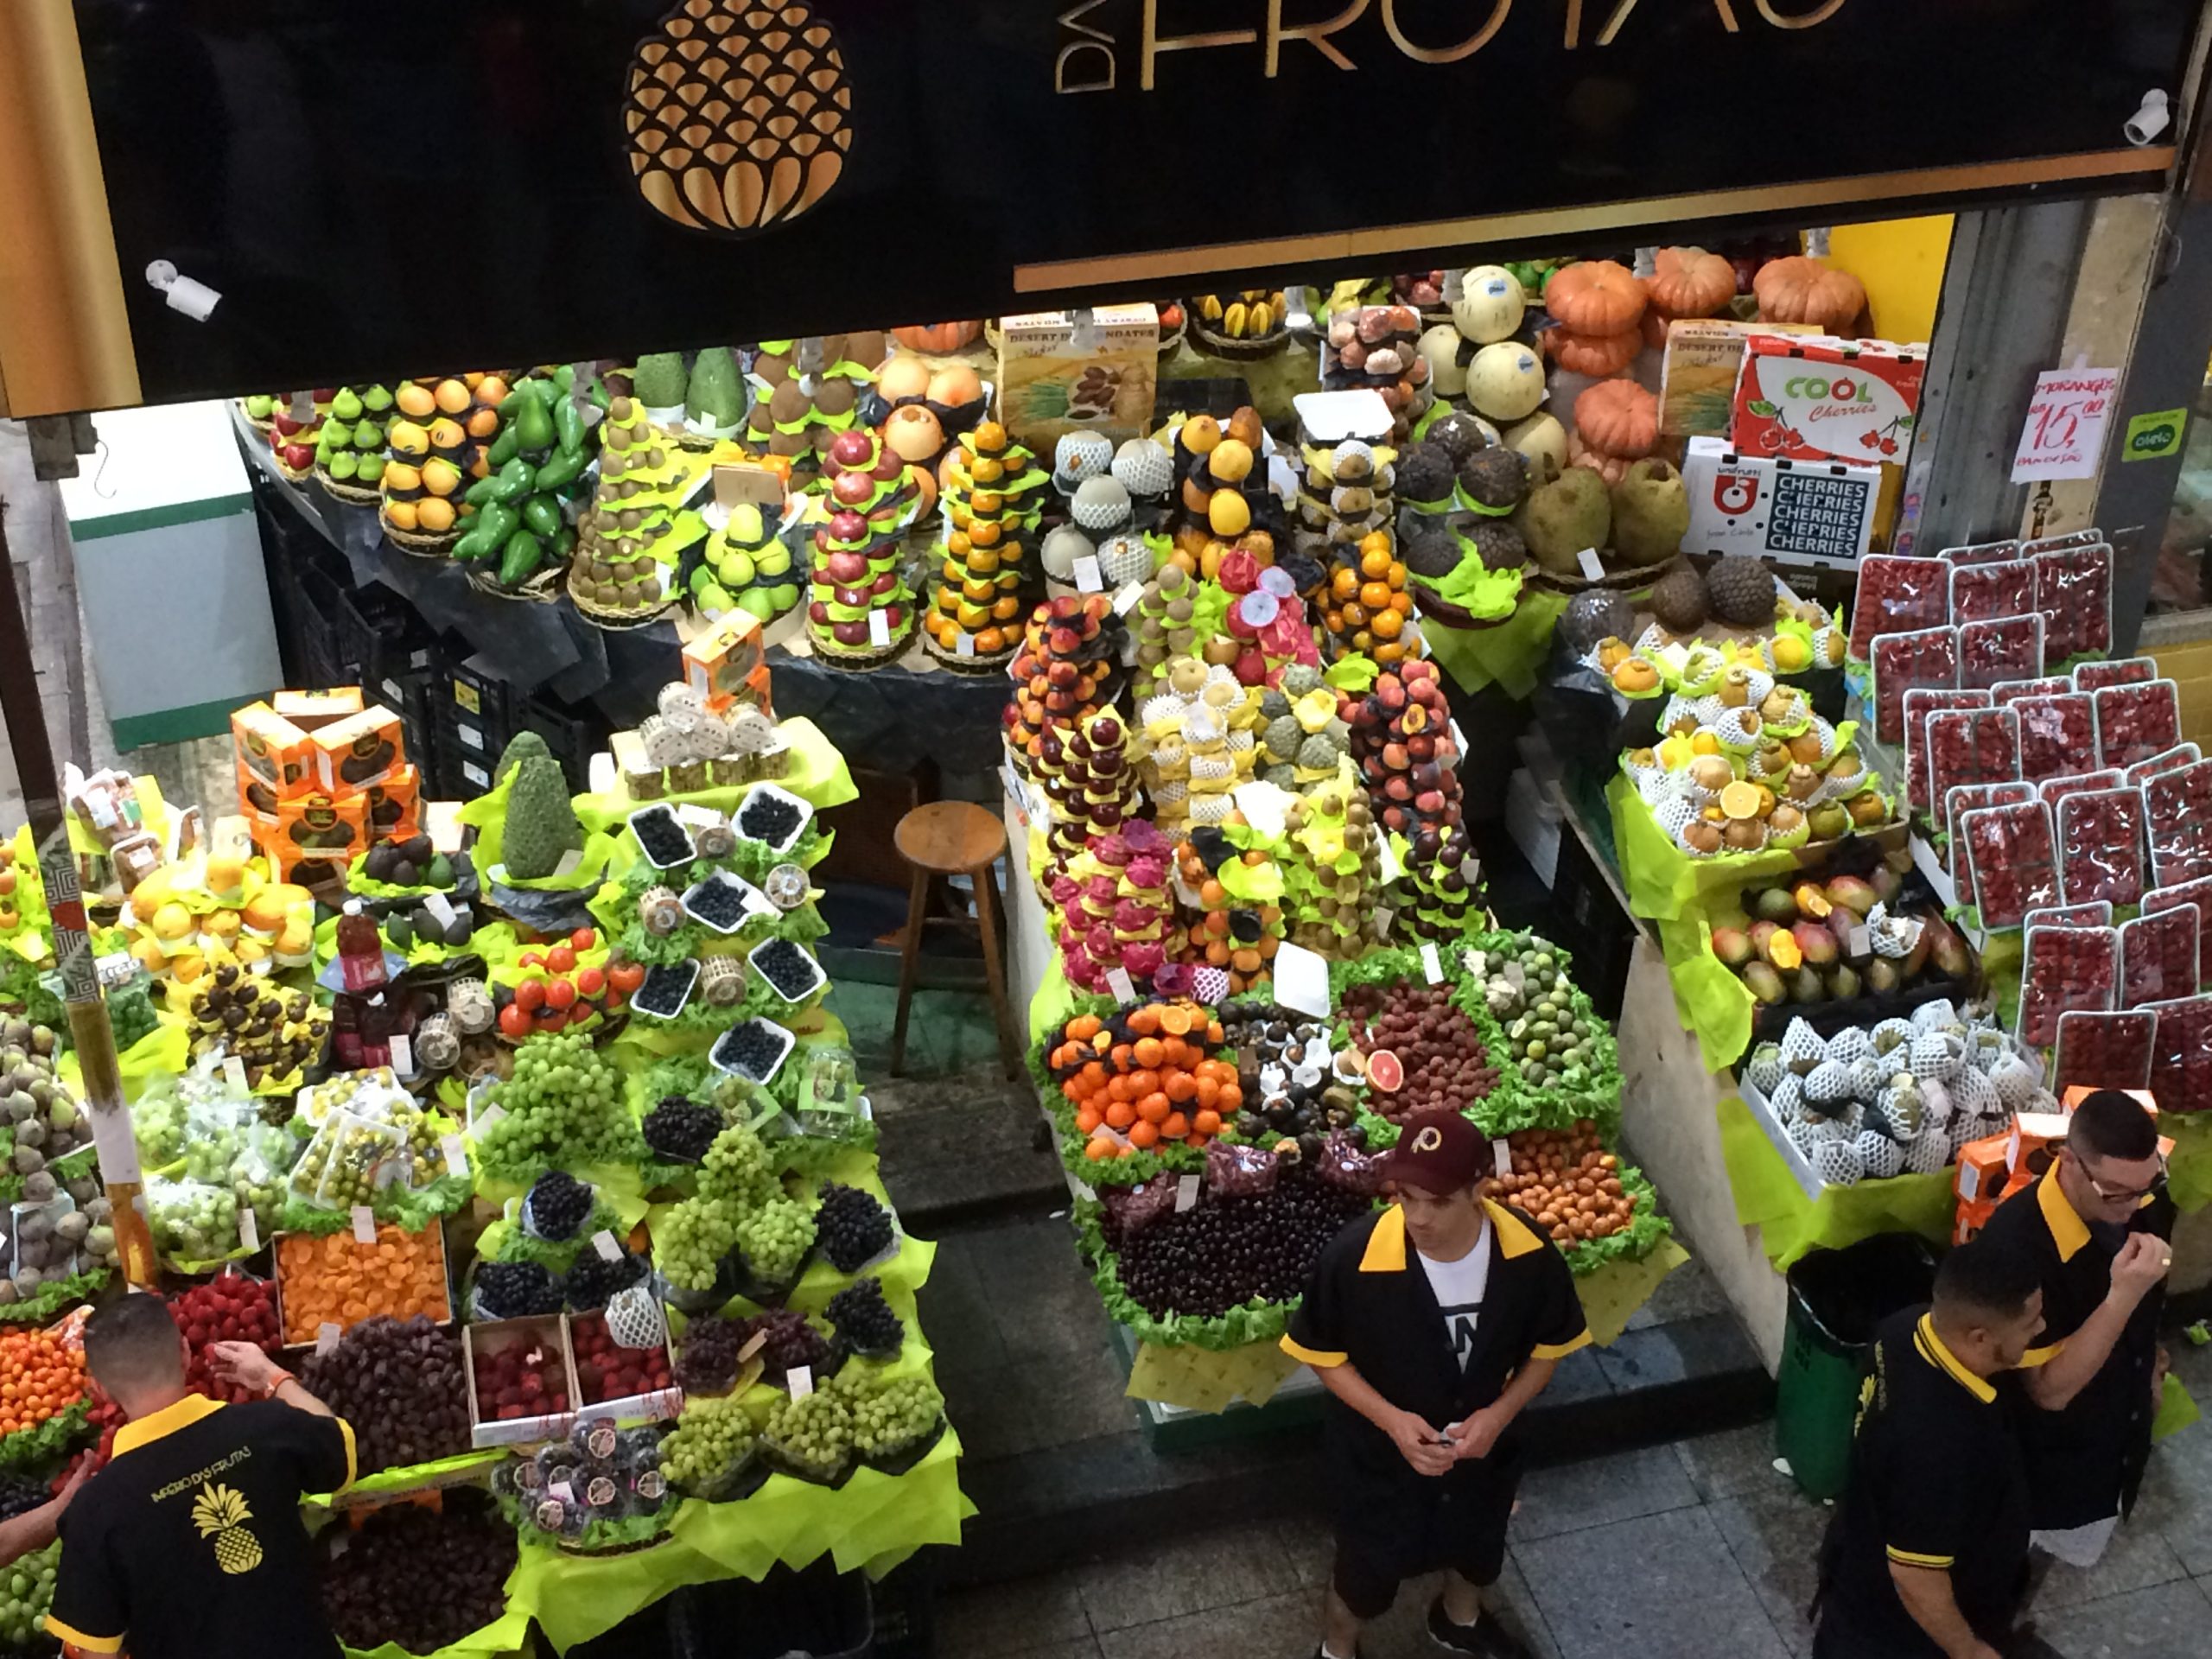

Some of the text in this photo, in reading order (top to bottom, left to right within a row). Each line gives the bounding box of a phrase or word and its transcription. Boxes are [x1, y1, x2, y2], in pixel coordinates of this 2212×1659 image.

[1141, 0, 1848, 92] FRU
[1785, 375, 1873, 403] COOL
[1808, 404, 1878, 423] Cherries
[1778, 476, 1866, 499] CHERRIES
[1774, 505, 1859, 527] CHERRIES
[1770, 534, 1854, 556] CHERRIES
